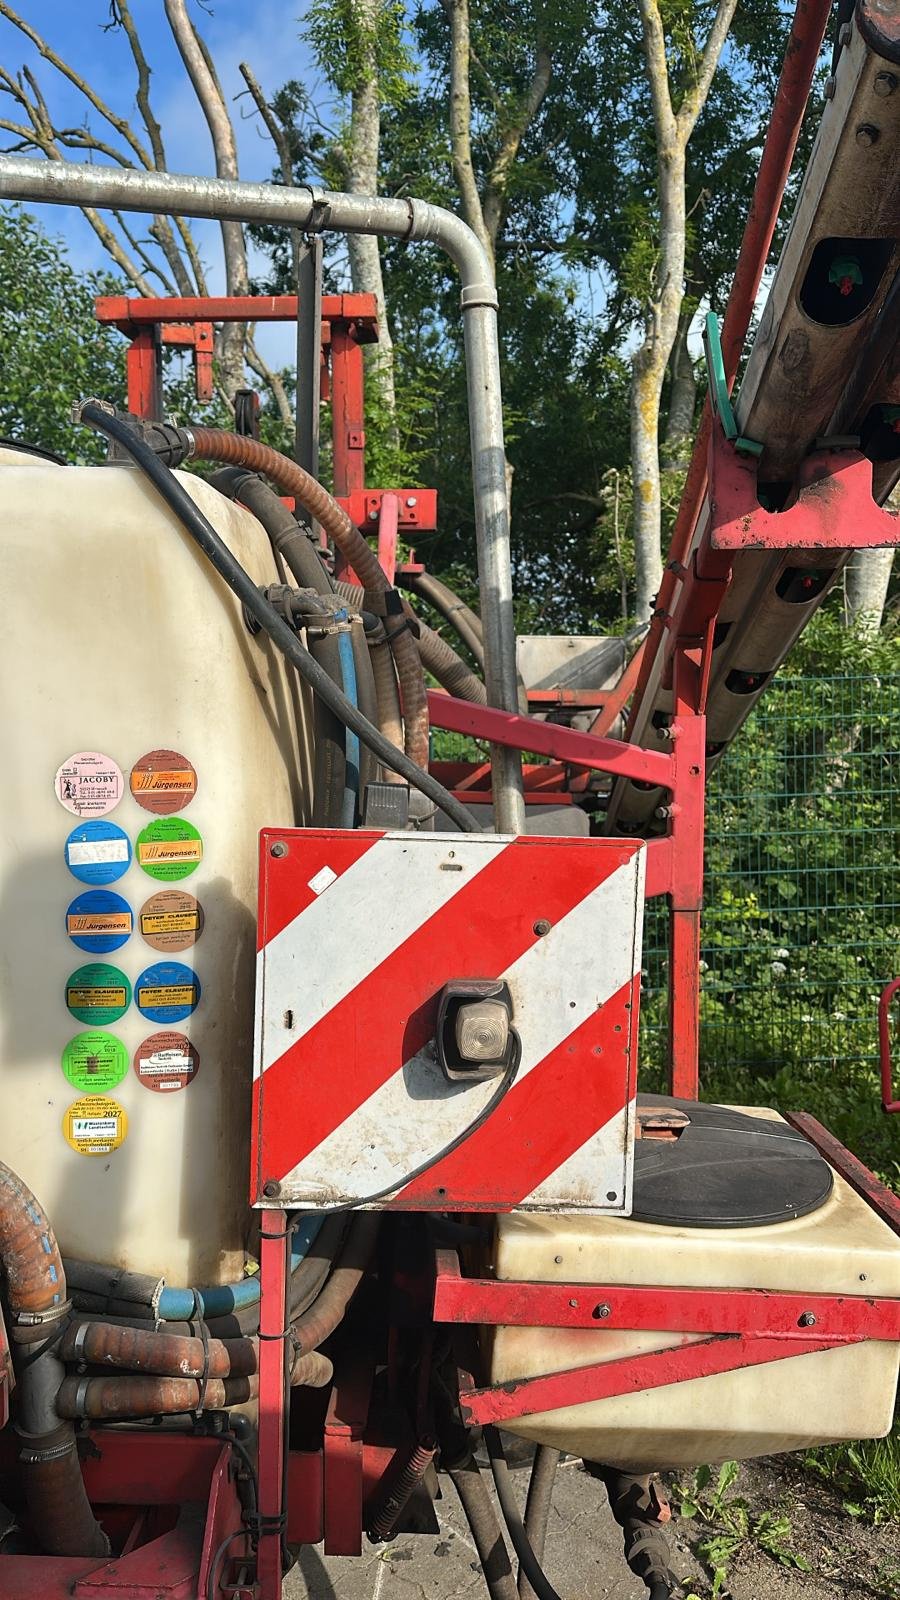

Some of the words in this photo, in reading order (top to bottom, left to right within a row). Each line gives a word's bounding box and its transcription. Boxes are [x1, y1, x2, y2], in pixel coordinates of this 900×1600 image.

[79, 776, 114, 784] JACOBY
[152, 781, 192, 790] Jürgensen
[158, 850, 197, 858] Jürgensen
[103, 1110, 122, 1118] 2027
